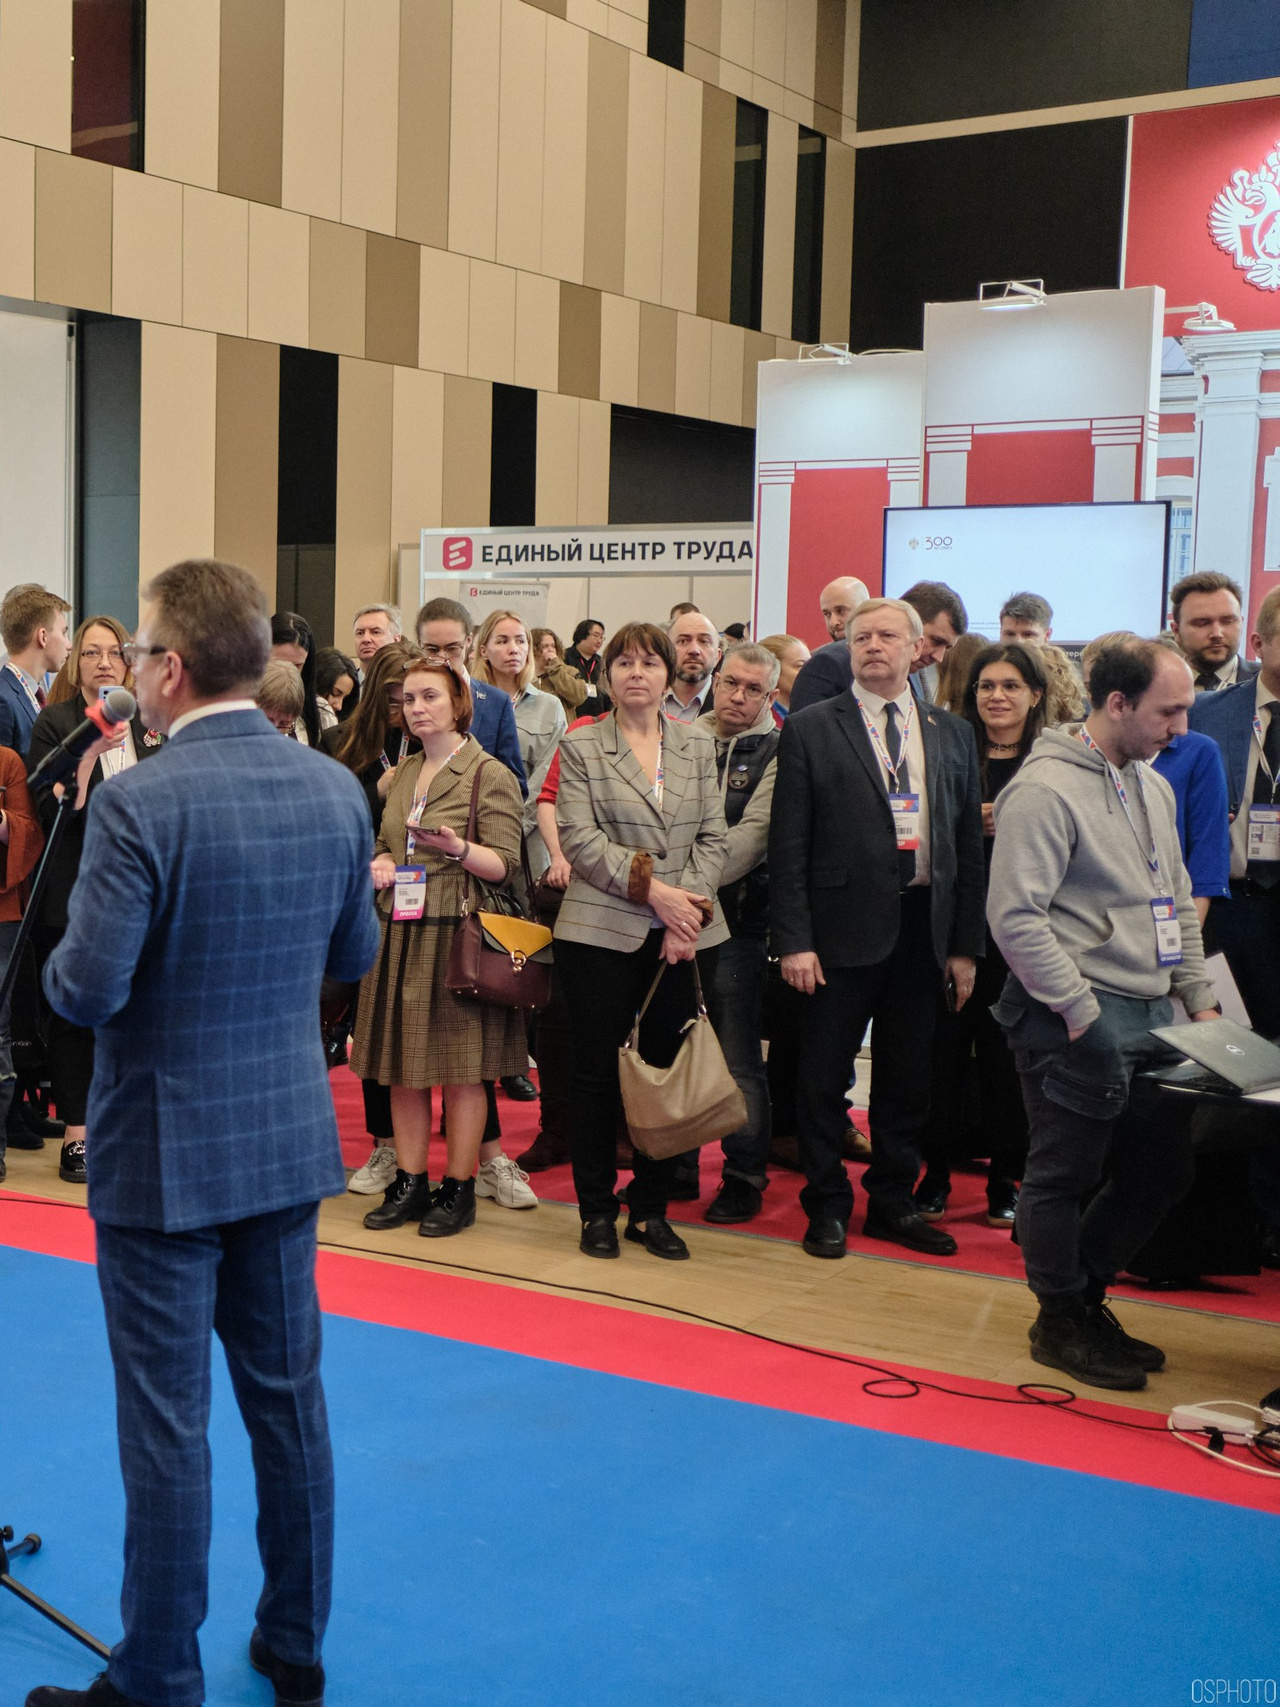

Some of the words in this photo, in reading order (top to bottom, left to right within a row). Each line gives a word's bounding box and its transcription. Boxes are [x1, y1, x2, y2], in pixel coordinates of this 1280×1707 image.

[481, 538, 582, 565] ЕДИНЫЙ
[589, 542, 666, 564] ЦЕНТР
[673, 540, 753, 563] ТРУДА
[925, 536, 953, 551] 300
